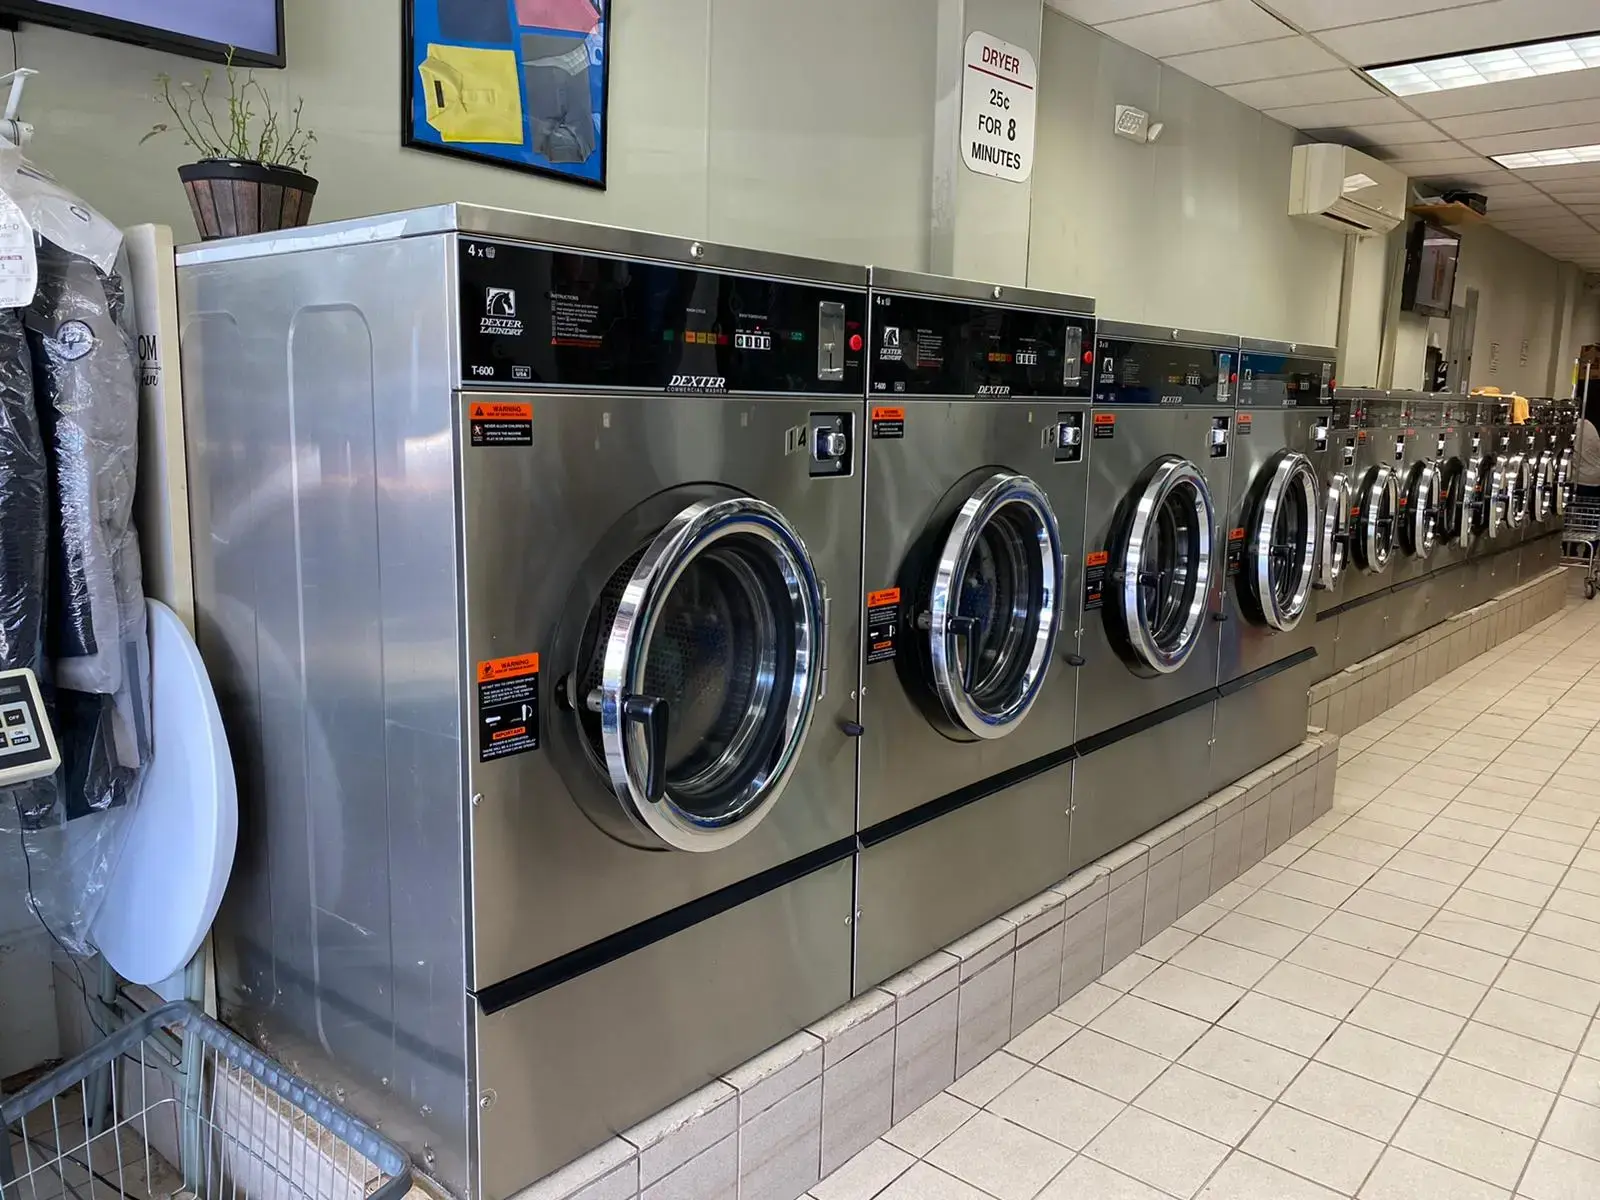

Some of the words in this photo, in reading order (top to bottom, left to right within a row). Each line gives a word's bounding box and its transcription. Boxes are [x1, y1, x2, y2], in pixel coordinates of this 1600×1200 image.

[982, 46, 1020, 74] DRYER
[978, 114, 1002, 137] FOR
[1007, 118, 1017, 141] 8
[971, 141, 1021, 170] MINUTES
[468, 244, 476, 256] 4
[480, 318, 522, 328] DEXTER
[479, 326, 524, 336] LAUNDRY
[471, 365, 494, 376] T-600
[668, 375, 726, 388] DEXTER
[977, 385, 1010, 395] DEXTER
[789, 426, 807, 451] 14
[501, 658, 529, 668] WARNING
[495, 728, 524, 738] IMPORTANT
